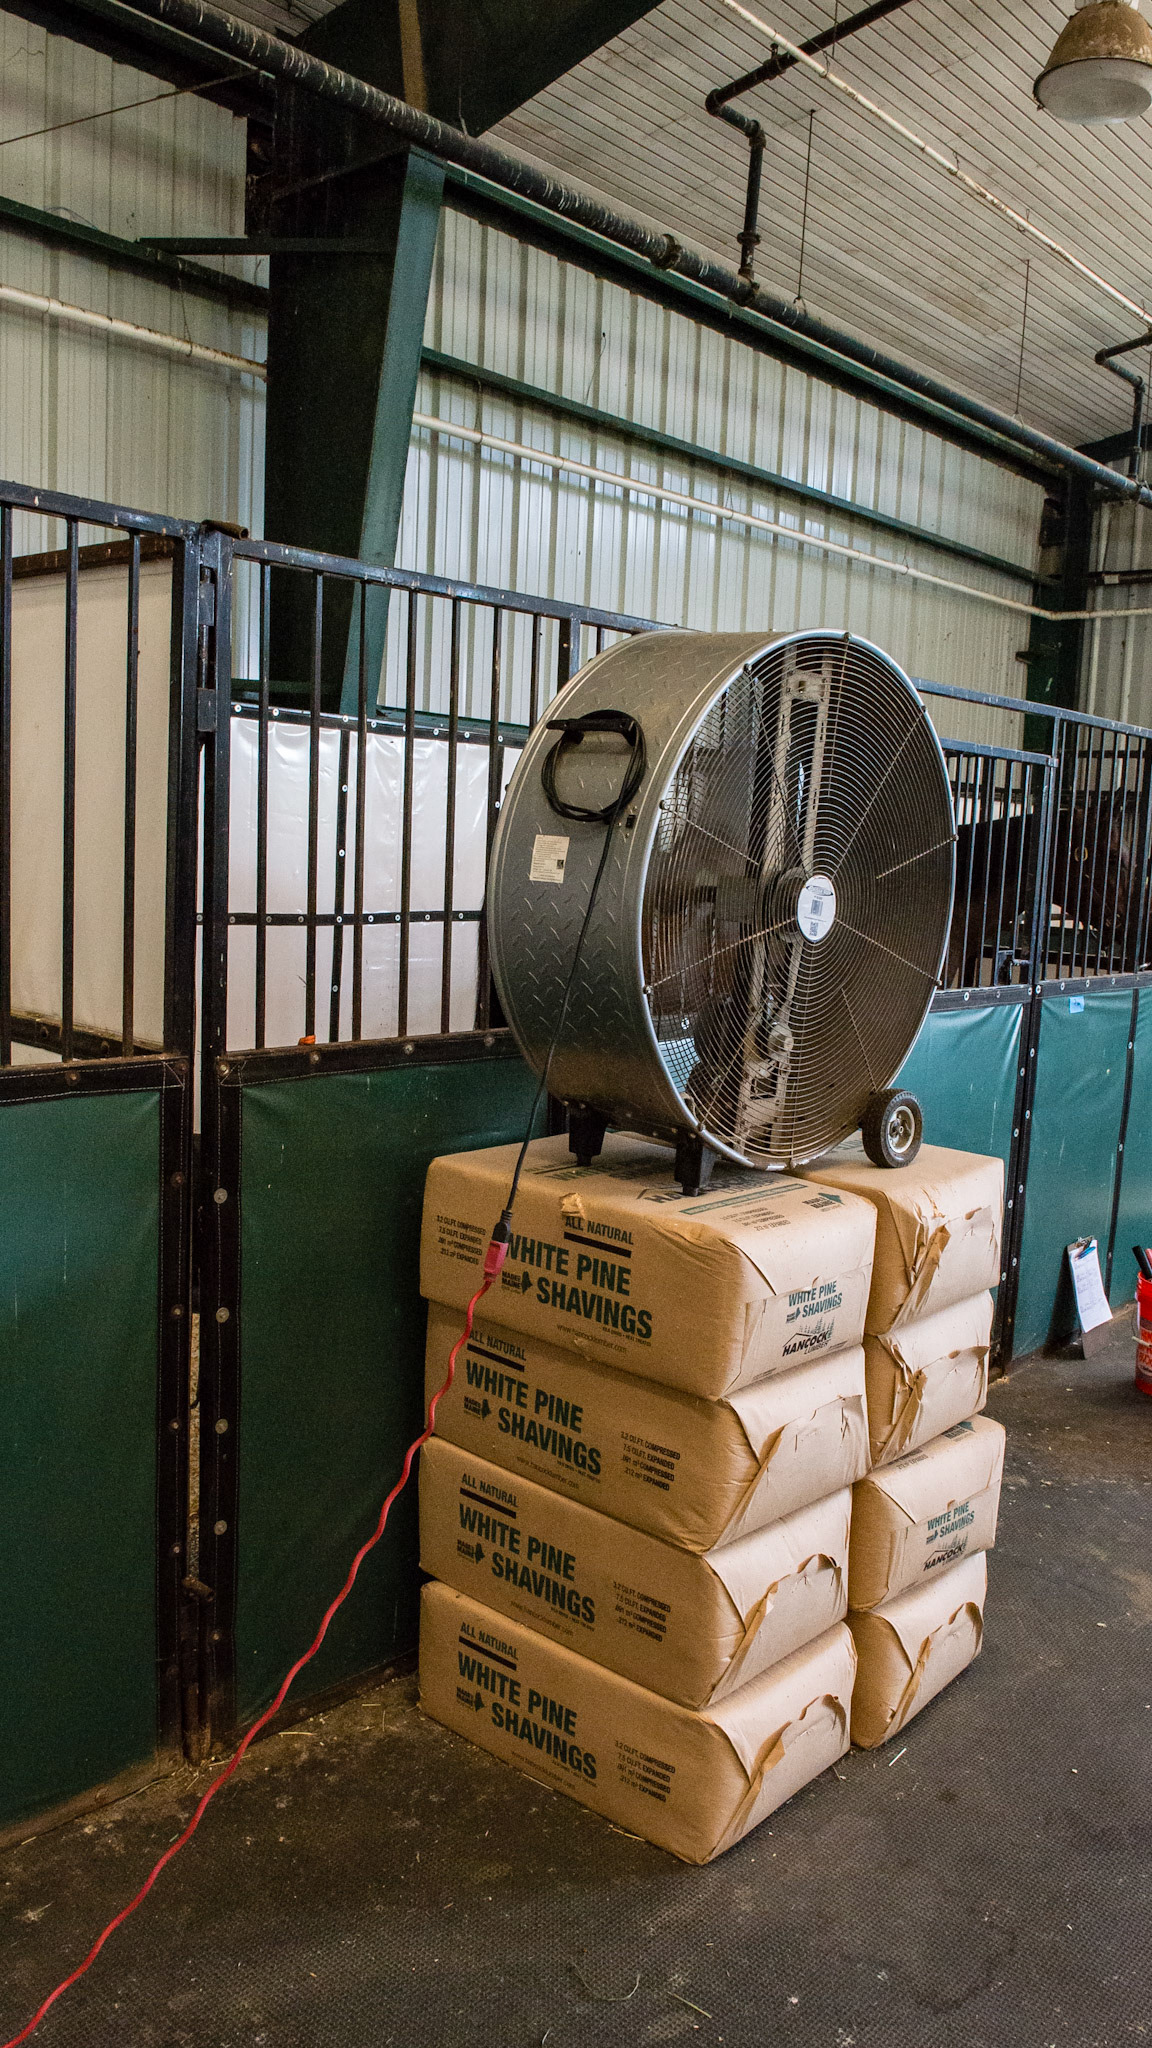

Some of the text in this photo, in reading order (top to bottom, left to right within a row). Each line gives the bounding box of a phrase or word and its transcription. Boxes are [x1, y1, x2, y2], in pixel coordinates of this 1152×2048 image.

[565, 1216, 634, 1245] ALL NATURAL
[506, 1233, 631, 1296] WHITE PINE
[536, 1276, 652, 1339] SHAVINGS
[788, 1281, 837, 1307] WHITE PINE
[802, 1293, 842, 1318] SHAVINGS
[469, 1330, 527, 1361] ALL NATURAL
[782, 1330, 829, 1357] HANCOCK
[466, 1360, 583, 1433] WHITE PINE
[498, 1407, 601, 1476] SHAVINGS
[645, 1440, 680, 1460] COMPRESSED
[640, 1461, 674, 1481] COMPRESSED
[647, 1453, 674, 1470] EXPANDED
[461, 1473, 518, 1507] ALL NATURAL
[643, 1474, 669, 1491] EXPANDED
[928, 1511, 951, 1531] WHITE
[954, 1501, 969, 1519] PINE
[940, 1511, 974, 1537] SHAVINGS
[460, 1503, 576, 1581] WHITE PINE
[923, 1546, 962, 1571] HANCOCK
[491, 1552, 595, 1623] SHAVINGS
[461, 1622, 518, 1660] ALL NATURAL
[458, 1651, 577, 1737] WHITE PINE
[492, 1702, 597, 1779] SHAVINGS
